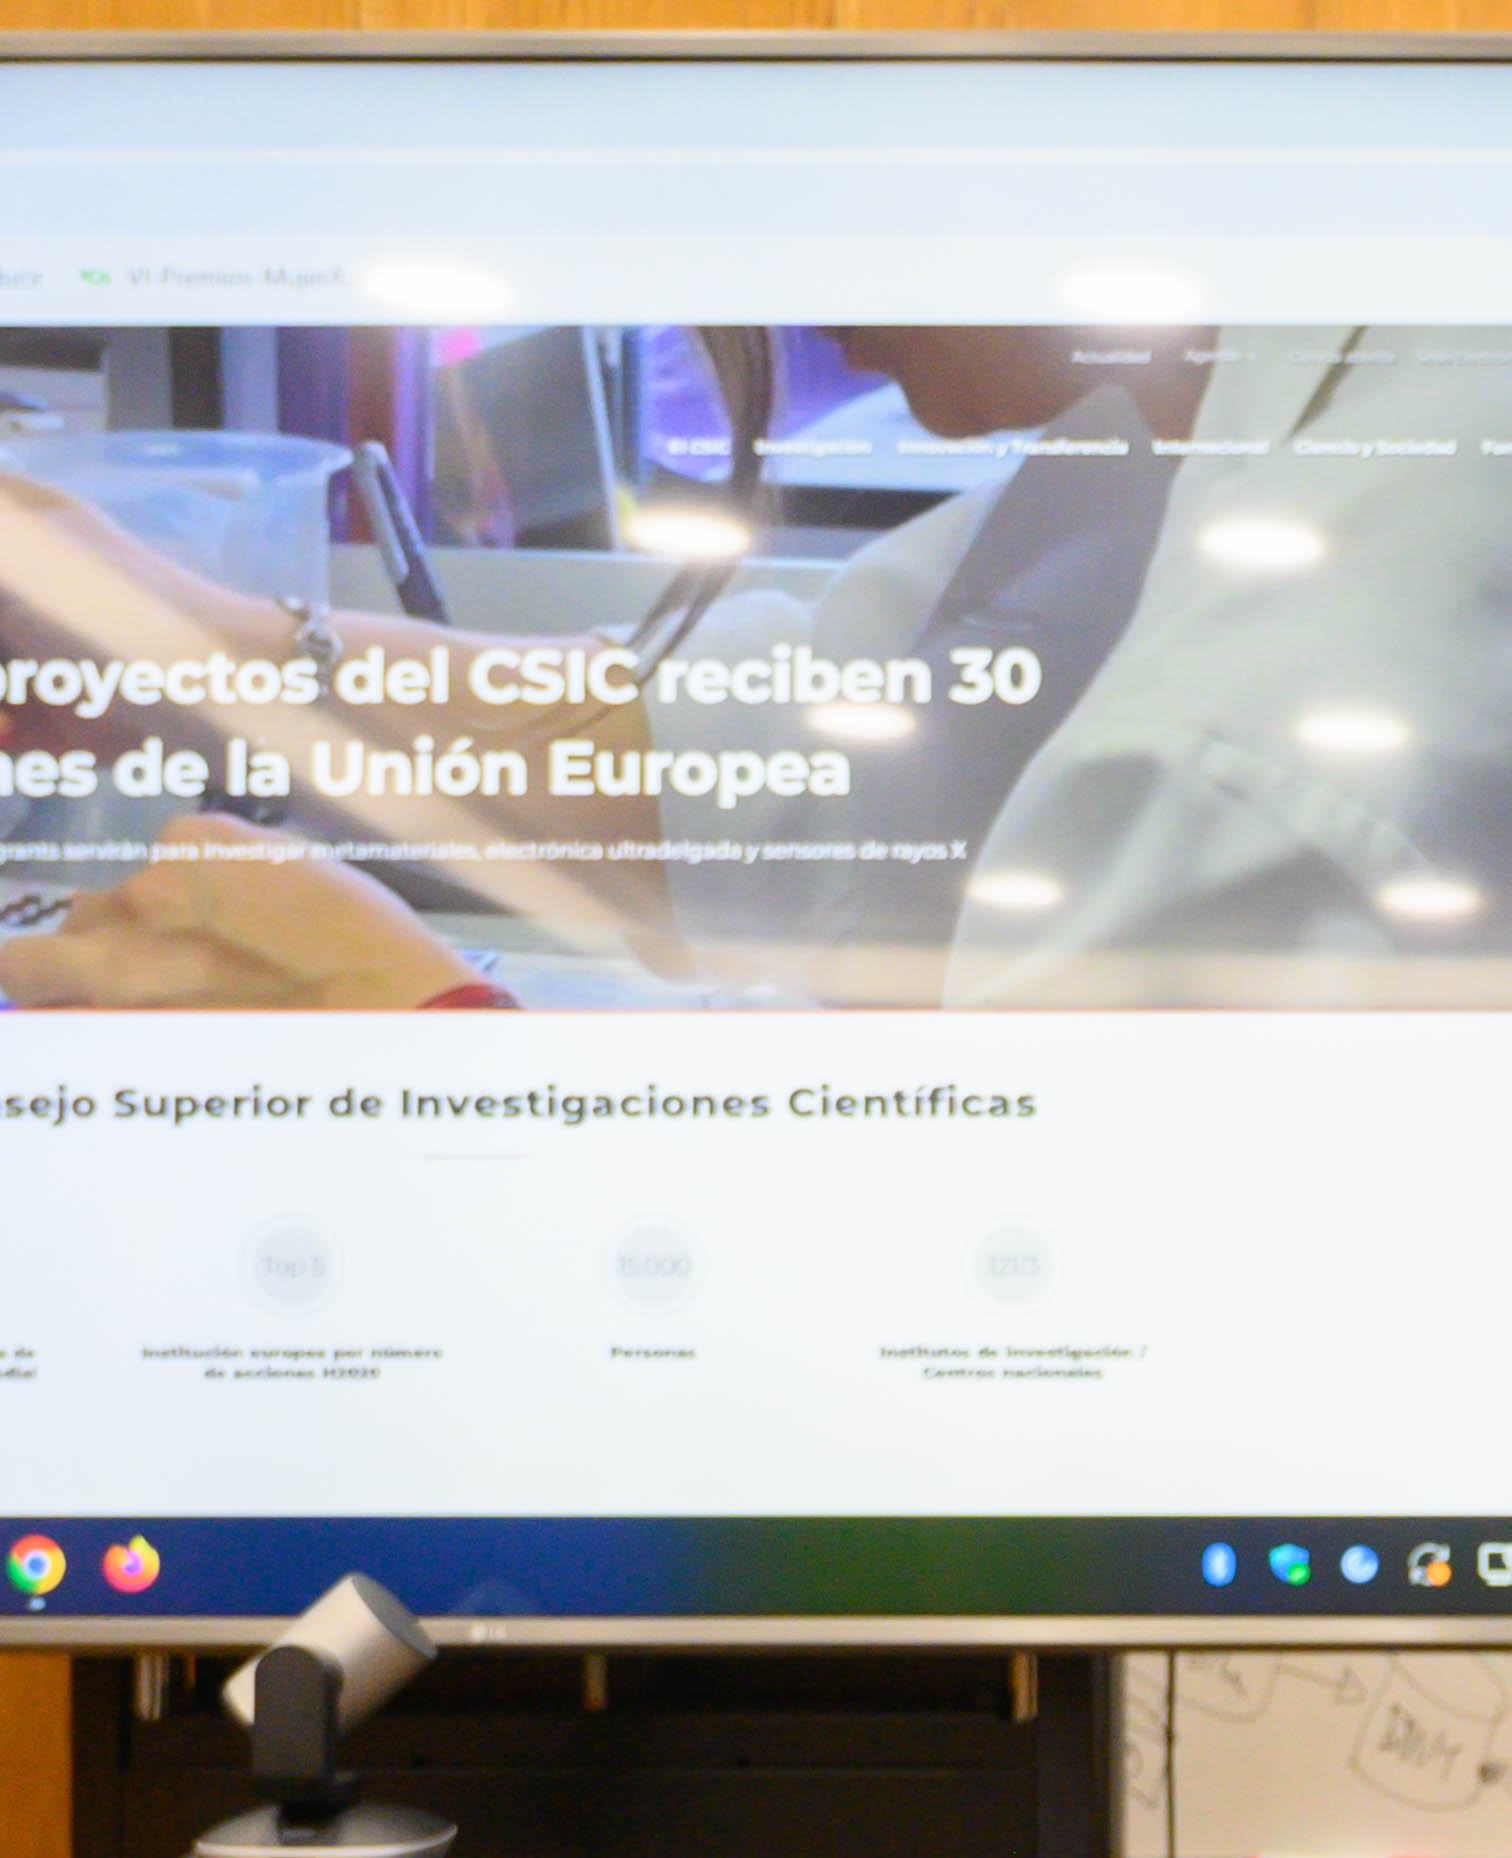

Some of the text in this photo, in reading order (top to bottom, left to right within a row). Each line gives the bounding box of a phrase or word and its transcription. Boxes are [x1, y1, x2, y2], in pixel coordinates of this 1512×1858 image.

[337, 647, 448, 704] del
[469, 648, 640, 704] CSIC
[657, 646, 932, 704] reciben
[948, 648, 1042, 704] 30
[113, 738, 209, 796] de
[226, 738, 290, 796] la
[312, 736, 527, 796] Unión
[549, 740, 851, 809] Europea
[150, 845, 200, 864] para
[205, 842, 307, 864] investigar
[486, 841, 604, 861] electrónica
[607, 840, 743, 864] ultradelgada
[744, 846, 761, 864] y
[762, 845, 856, 861] sensores
[859, 842, 888, 861] de
[891, 845, 948, 864] rayos
[950, 842, 968, 860] X
[113, 1085, 312, 1125] Superior
[328, 1088, 383, 1118] de
[399, 1085, 772, 1125] Investigaciones
[788, 1085, 1039, 1118] Científicas
[141, 1345, 244, 1360] Institución
[249, 1348, 328, 1363] europea
[609, 1345, 697, 1360] Personas
[977, 1346, 1000, 1360] de
[233, 1366, 317, 1380] acciones
[322, 1366, 382, 1380] H2020
[922, 1365, 1104, 1380] Centros nacionales
